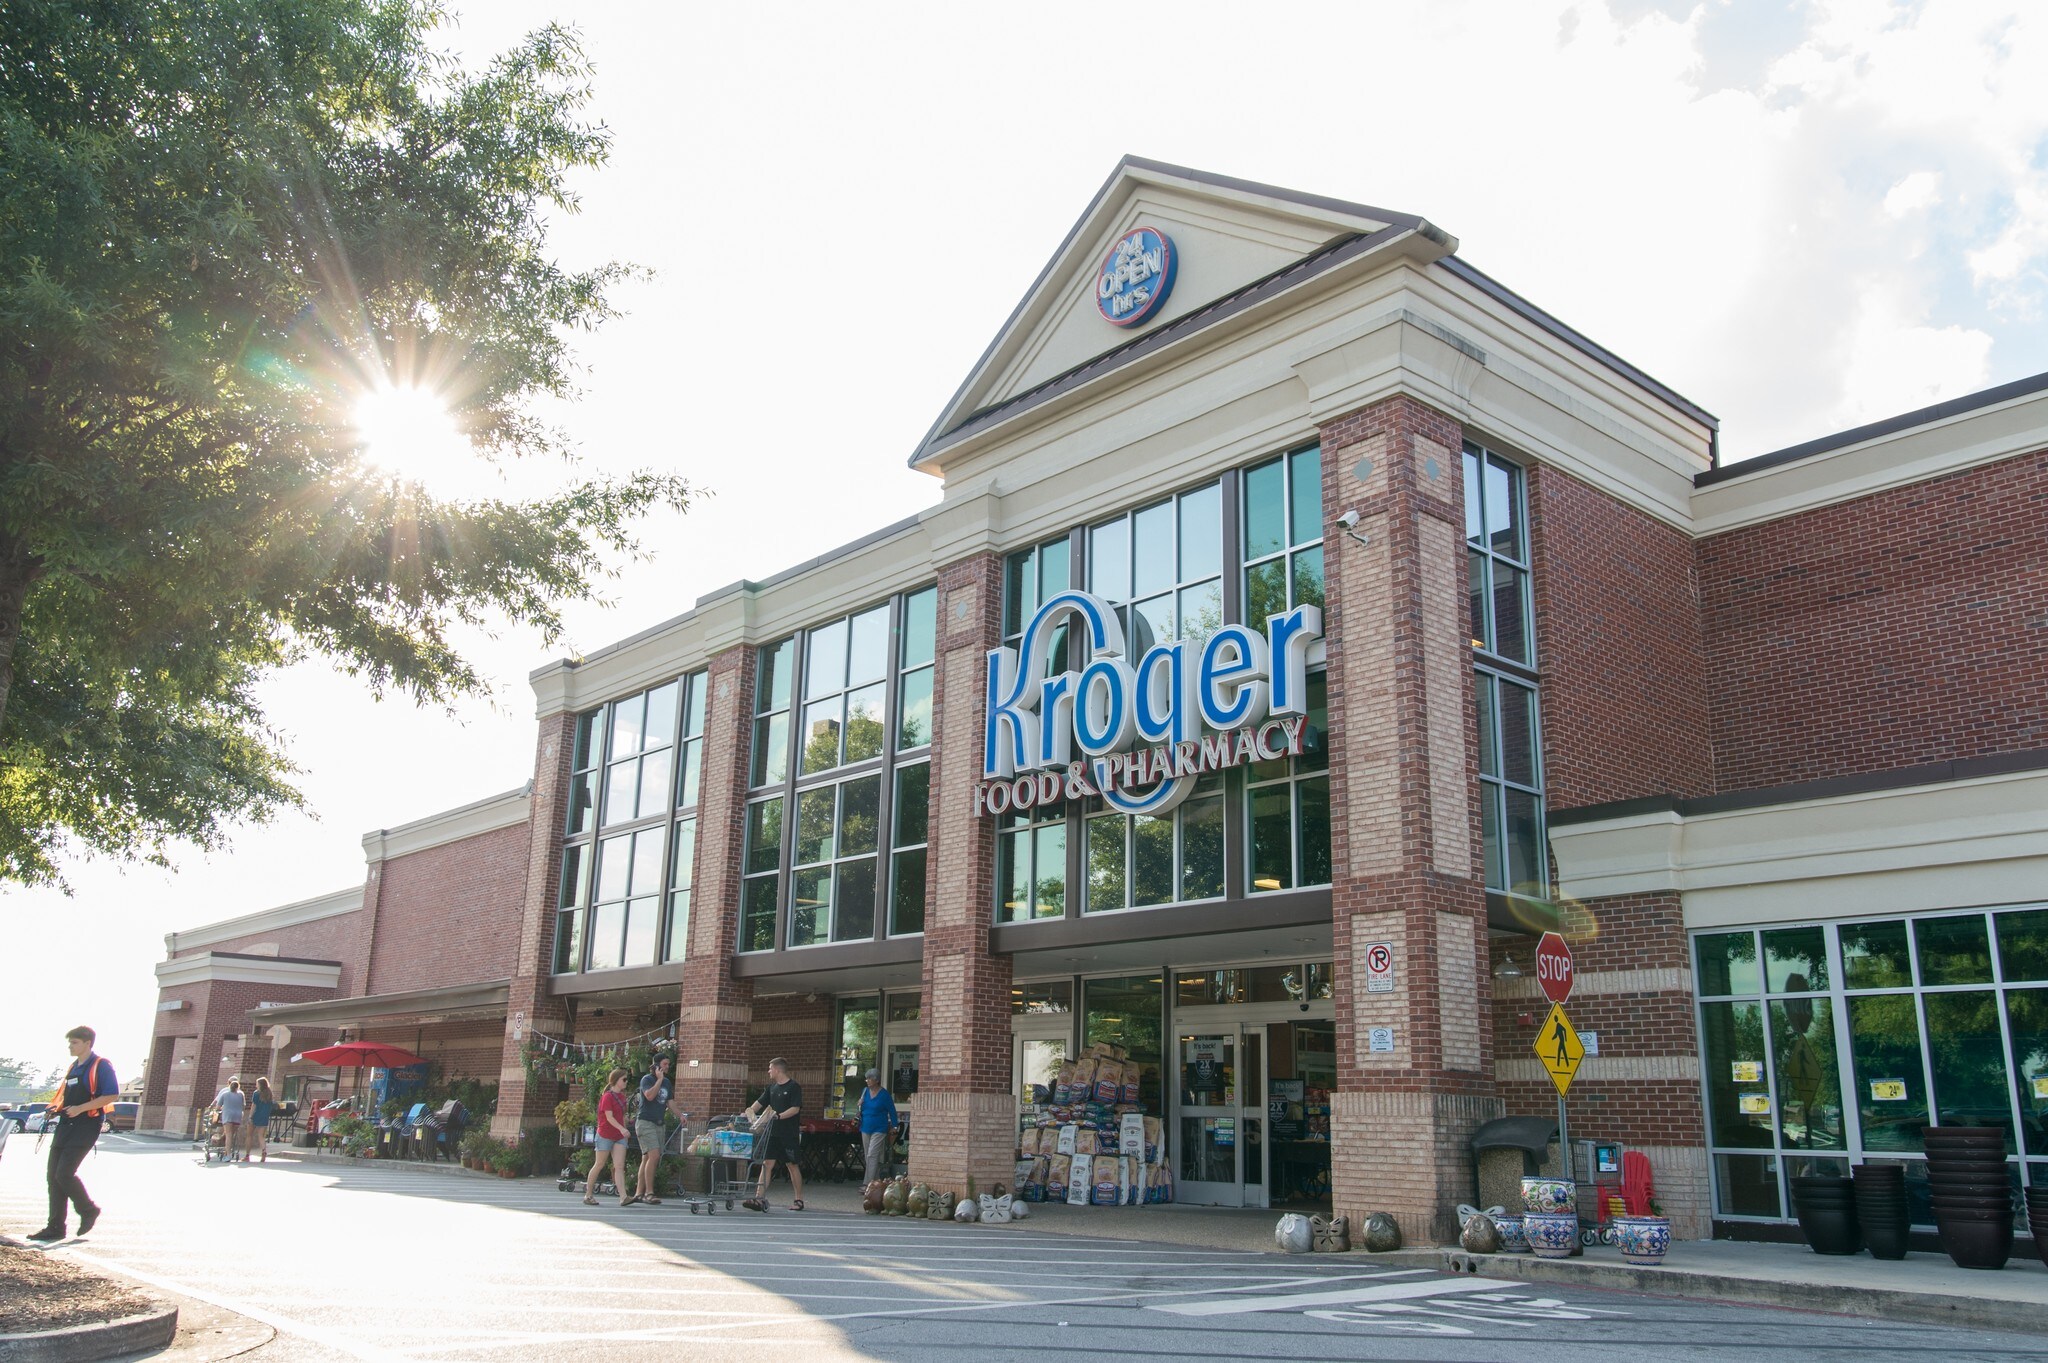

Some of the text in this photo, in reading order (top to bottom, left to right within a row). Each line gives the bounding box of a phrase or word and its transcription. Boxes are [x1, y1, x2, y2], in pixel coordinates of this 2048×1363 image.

[1115, 232, 1144, 267] 24
[1100, 247, 1161, 299] OPEN
[984, 590, 1321, 815] Kroger
[974, 715, 1309, 817] FOOD & PHARMACY
[1539, 953, 1570, 982] STOP
[1200, 1060, 1210, 1069] 2X
[1270, 1102, 1283, 1112] 2X
